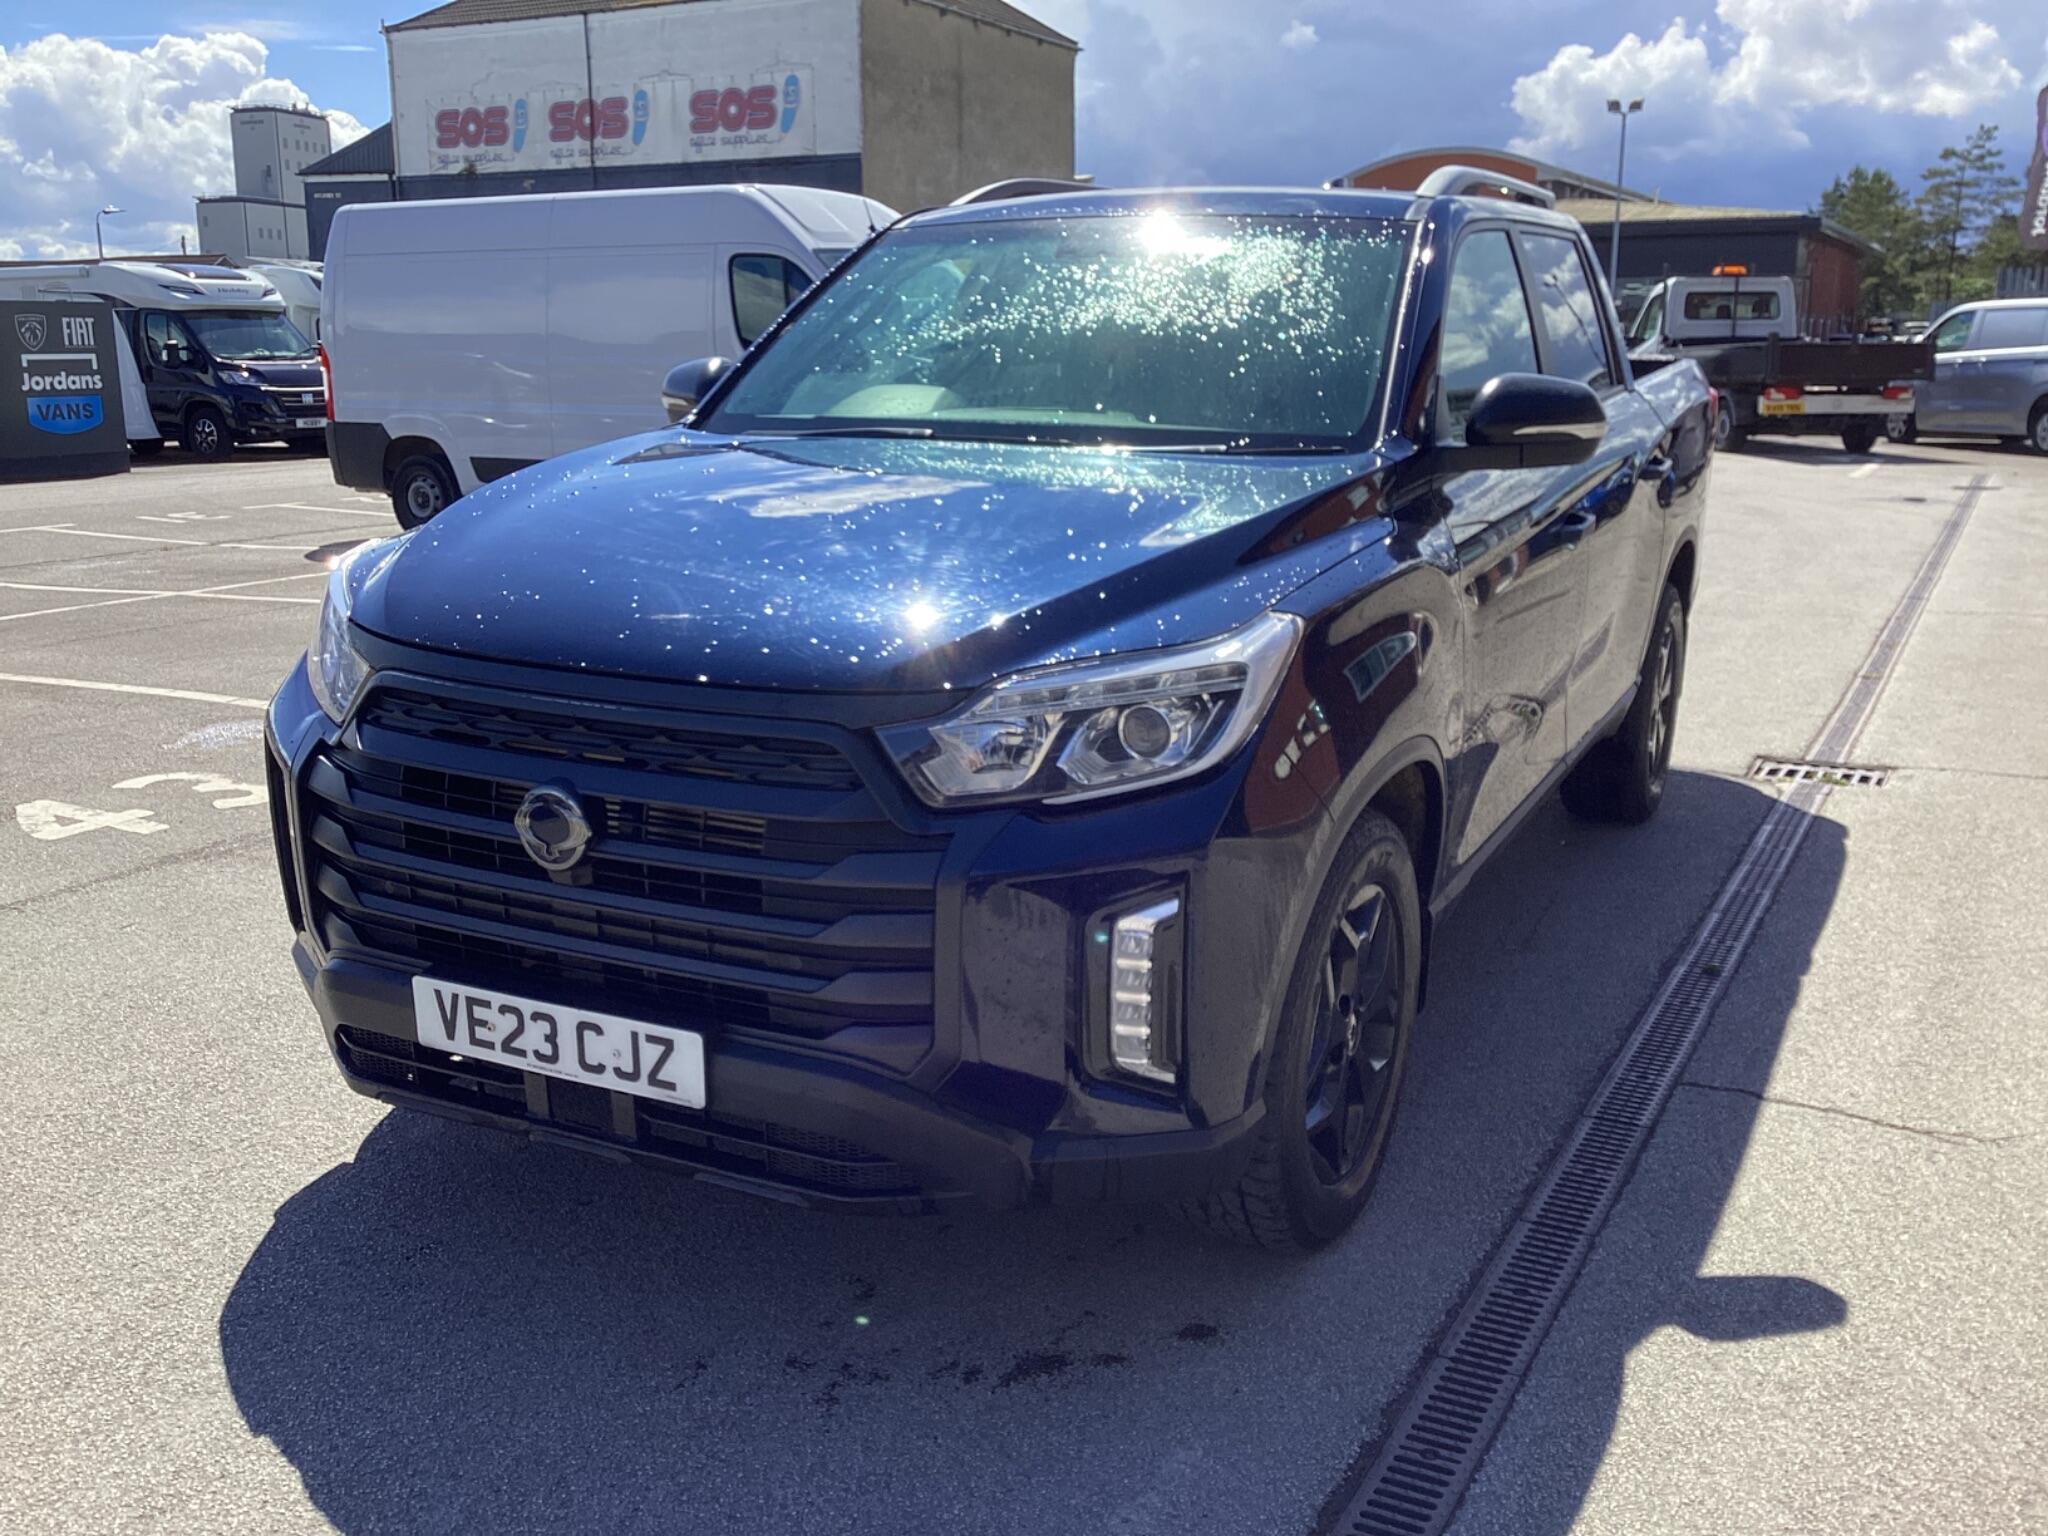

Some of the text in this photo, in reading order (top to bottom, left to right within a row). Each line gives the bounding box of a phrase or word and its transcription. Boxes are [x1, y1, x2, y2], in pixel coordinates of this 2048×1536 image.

[436, 105, 511, 149] SOS
[549, 95, 629, 142] SOS
[690, 84, 778, 134] SOS
[61, 317, 95, 346] FIAT
[21, 371, 103, 391] Jordans
[36, 403, 94, 421] VANS
[433, 988, 677, 1092] VE23 CJZ
